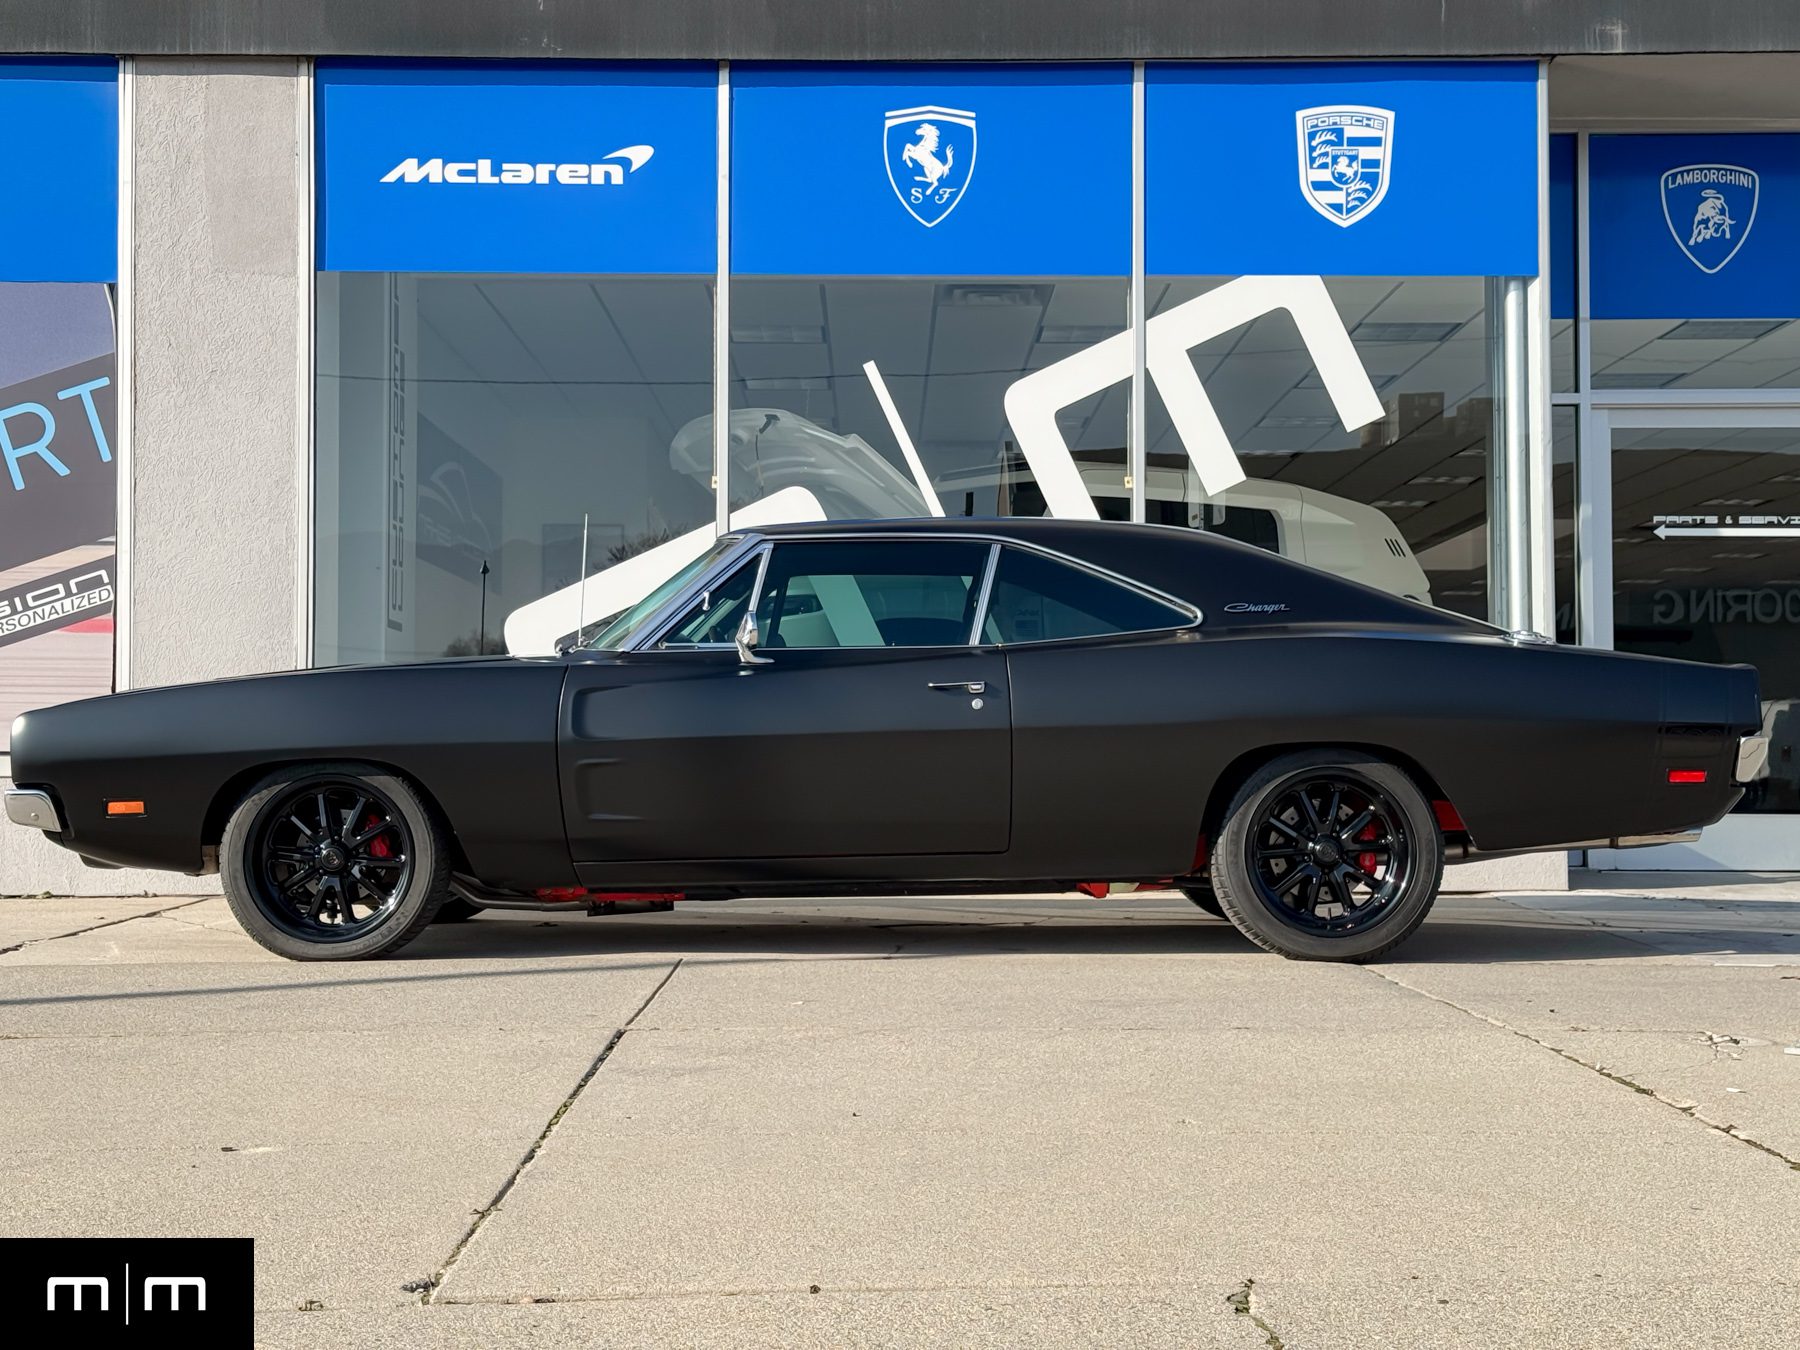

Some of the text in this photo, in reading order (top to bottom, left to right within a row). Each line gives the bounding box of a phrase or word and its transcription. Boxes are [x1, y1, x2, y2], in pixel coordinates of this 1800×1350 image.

[1307, 116, 1384, 131] PORSCHE
[379, 157, 624, 185] McLaren
[1668, 170, 1752, 189] LAMBORGHINI
[910, 187, 923, 204] S
[0, 377, 112, 490] RT
[1653, 515, 1718, 524] PARTS
[1725, 515, 1733, 524] &
[1224, 602, 1290, 614] Charger
